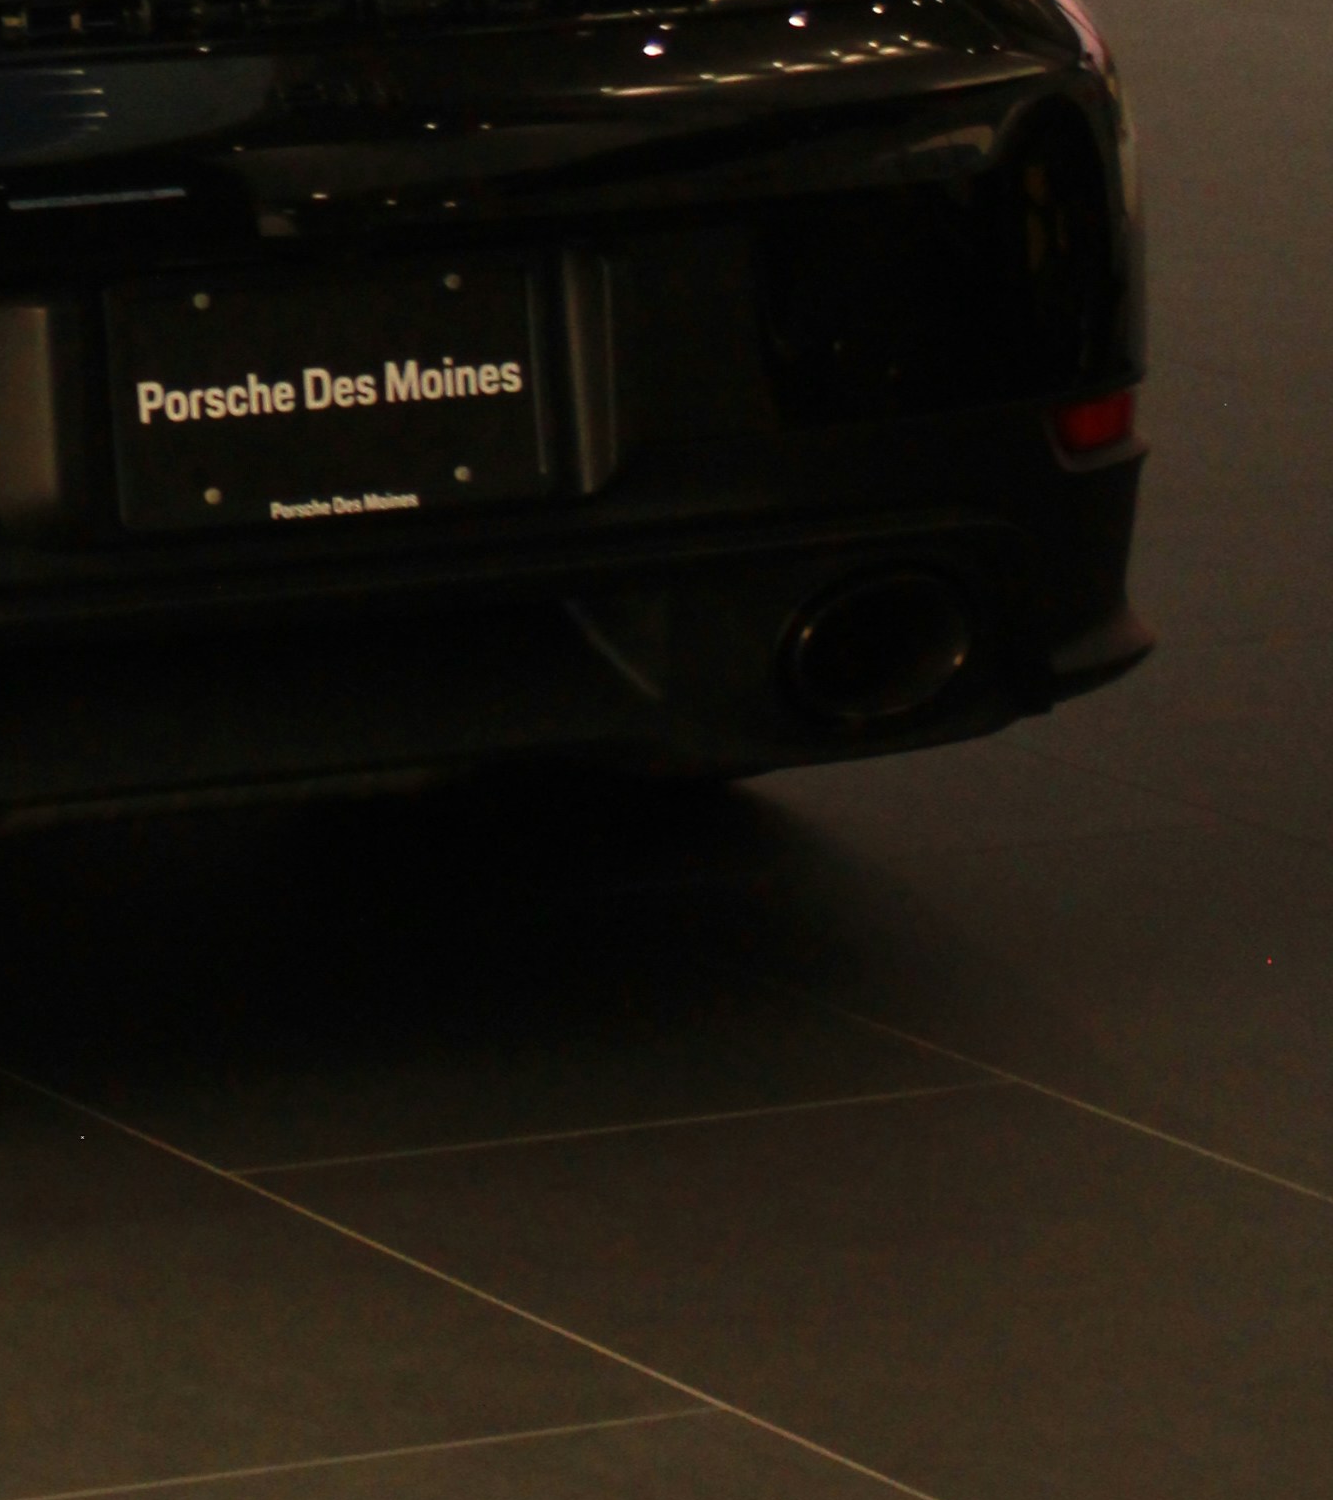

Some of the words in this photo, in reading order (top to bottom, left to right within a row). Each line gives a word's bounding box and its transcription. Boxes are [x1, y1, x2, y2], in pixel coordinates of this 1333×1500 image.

[137, 373, 295, 424] Porsche
[303, 367, 377, 410] Des
[384, 357, 522, 402] Moines
[270, 499, 331, 520] Porsche
[332, 496, 363, 514] Des
